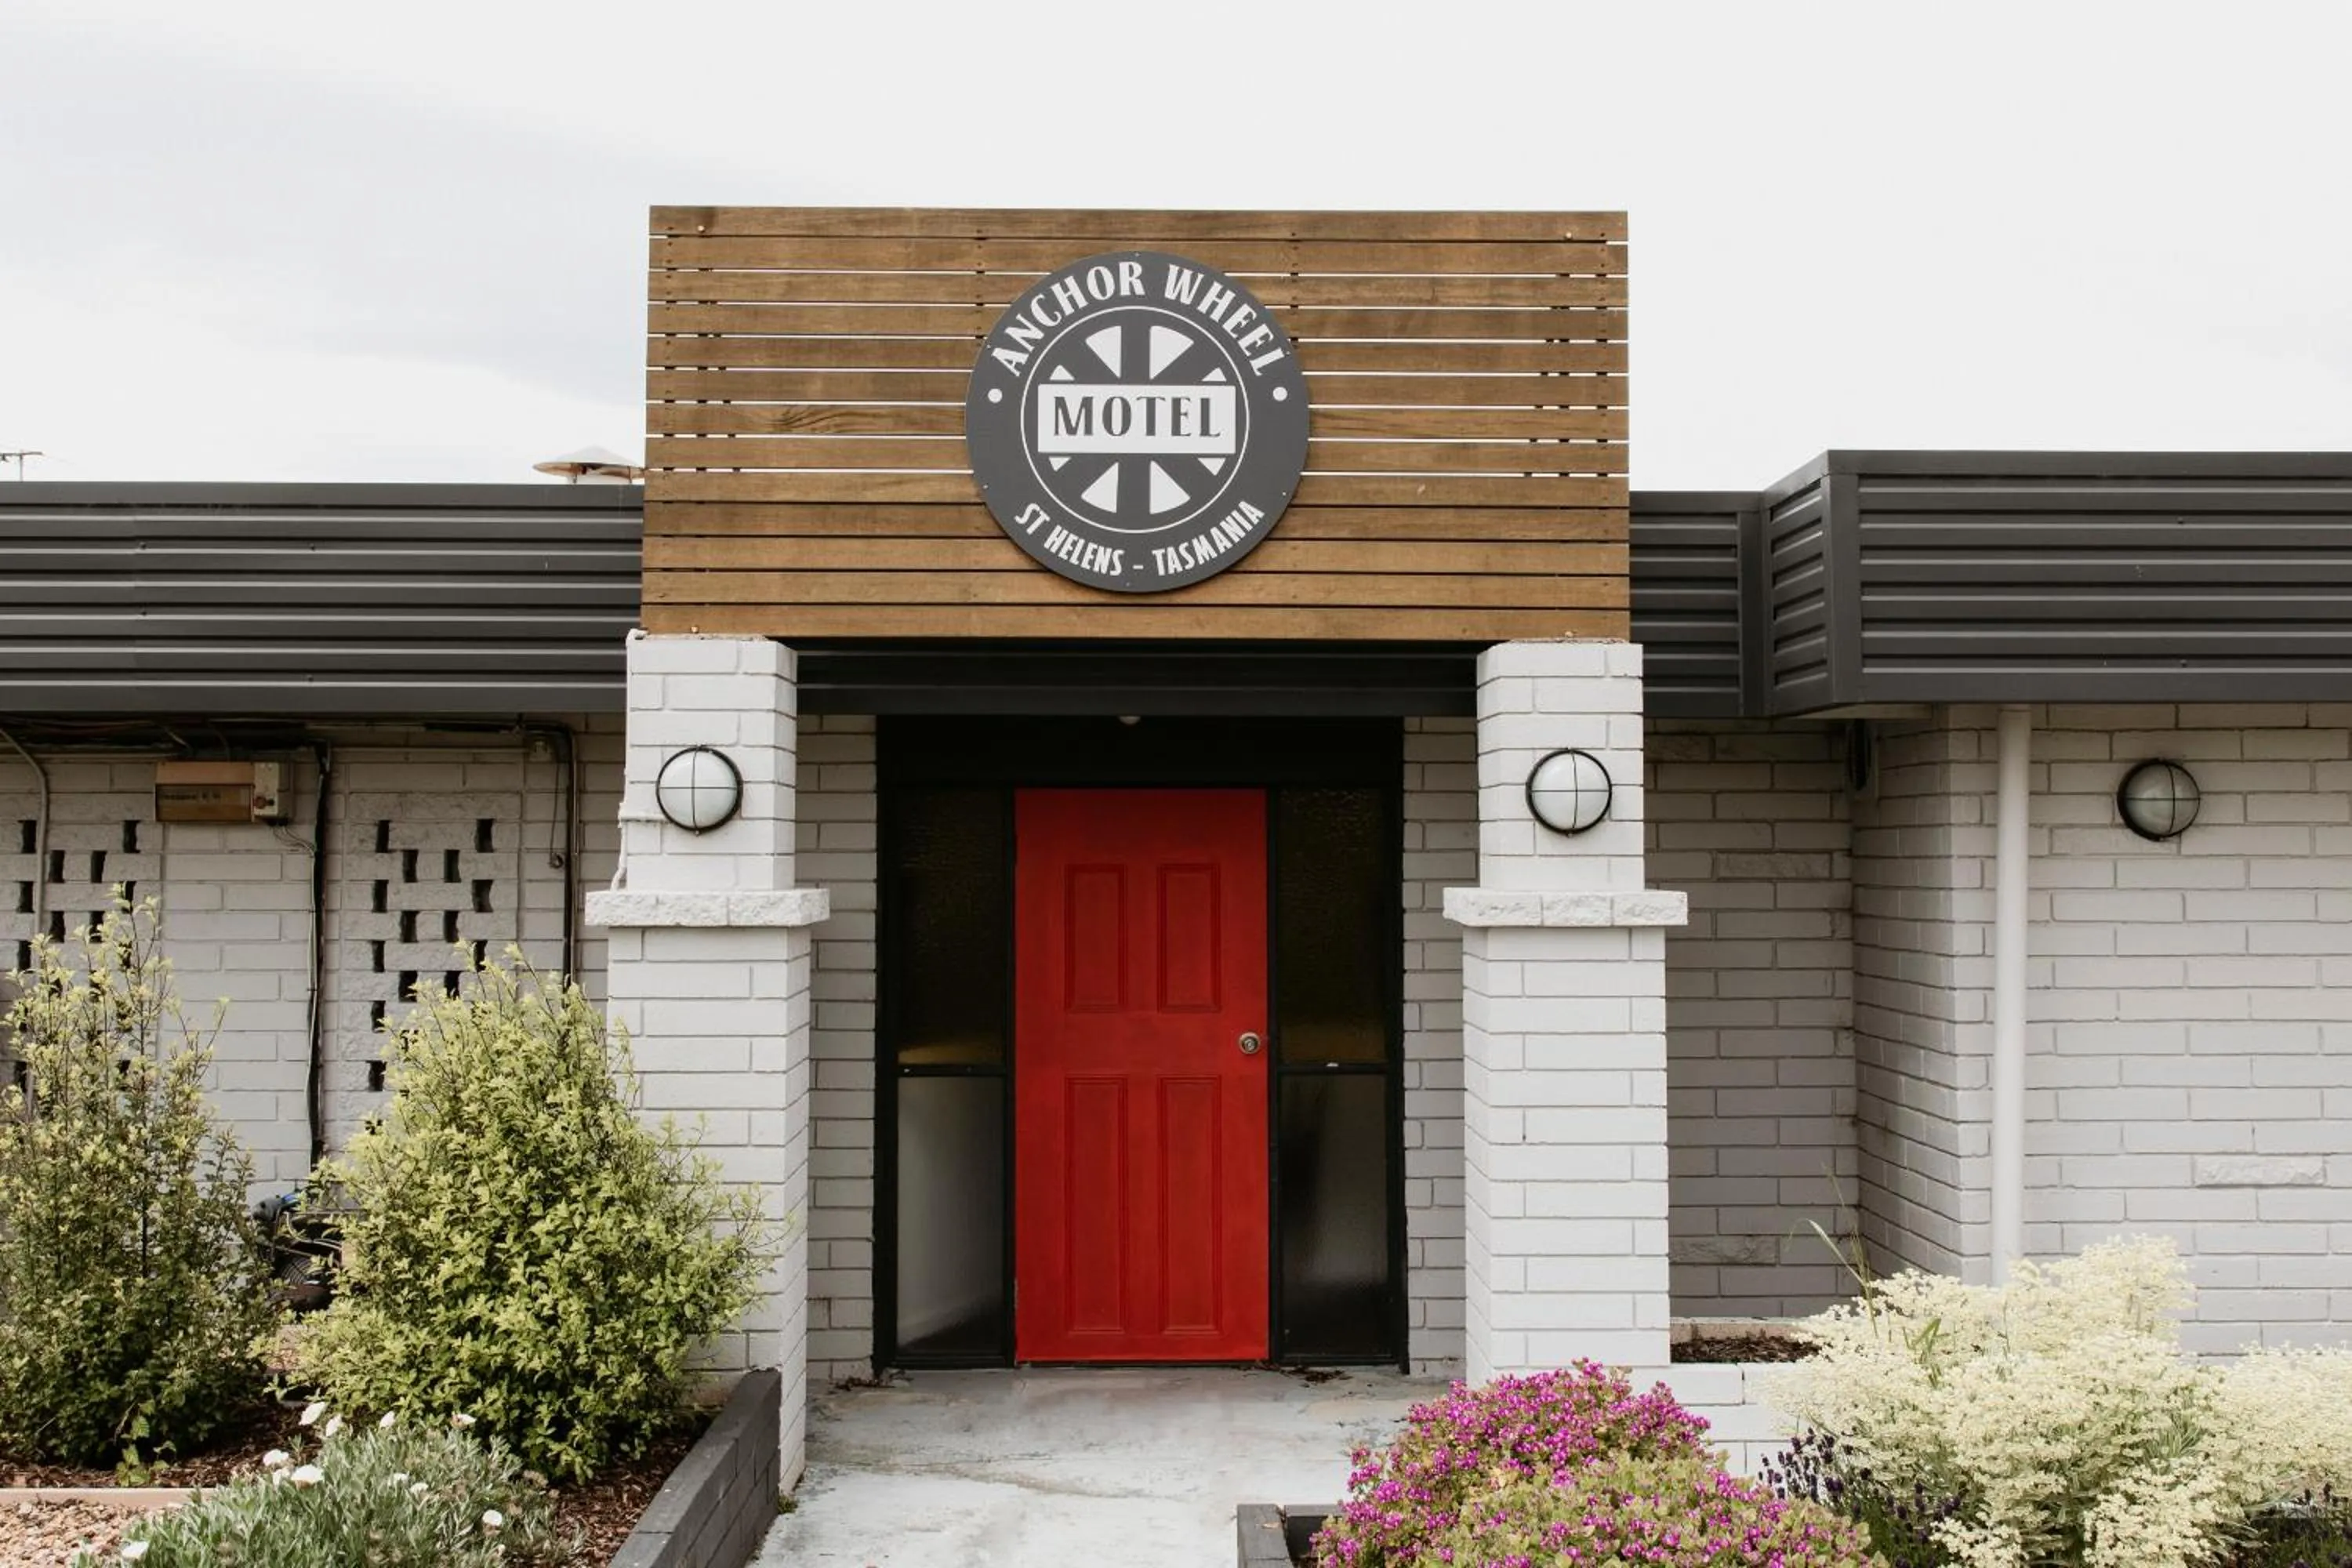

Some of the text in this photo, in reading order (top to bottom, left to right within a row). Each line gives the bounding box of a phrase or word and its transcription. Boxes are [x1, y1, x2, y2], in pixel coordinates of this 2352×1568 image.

[991, 261, 1285, 377] ANCHOR WHEEL
[1053, 395, 1221, 437] MOTEL
[1014, 503, 1051, 535] ST
[1044, 524, 1125, 576] HELENS
[1151, 500, 1265, 576] TASMANIA
